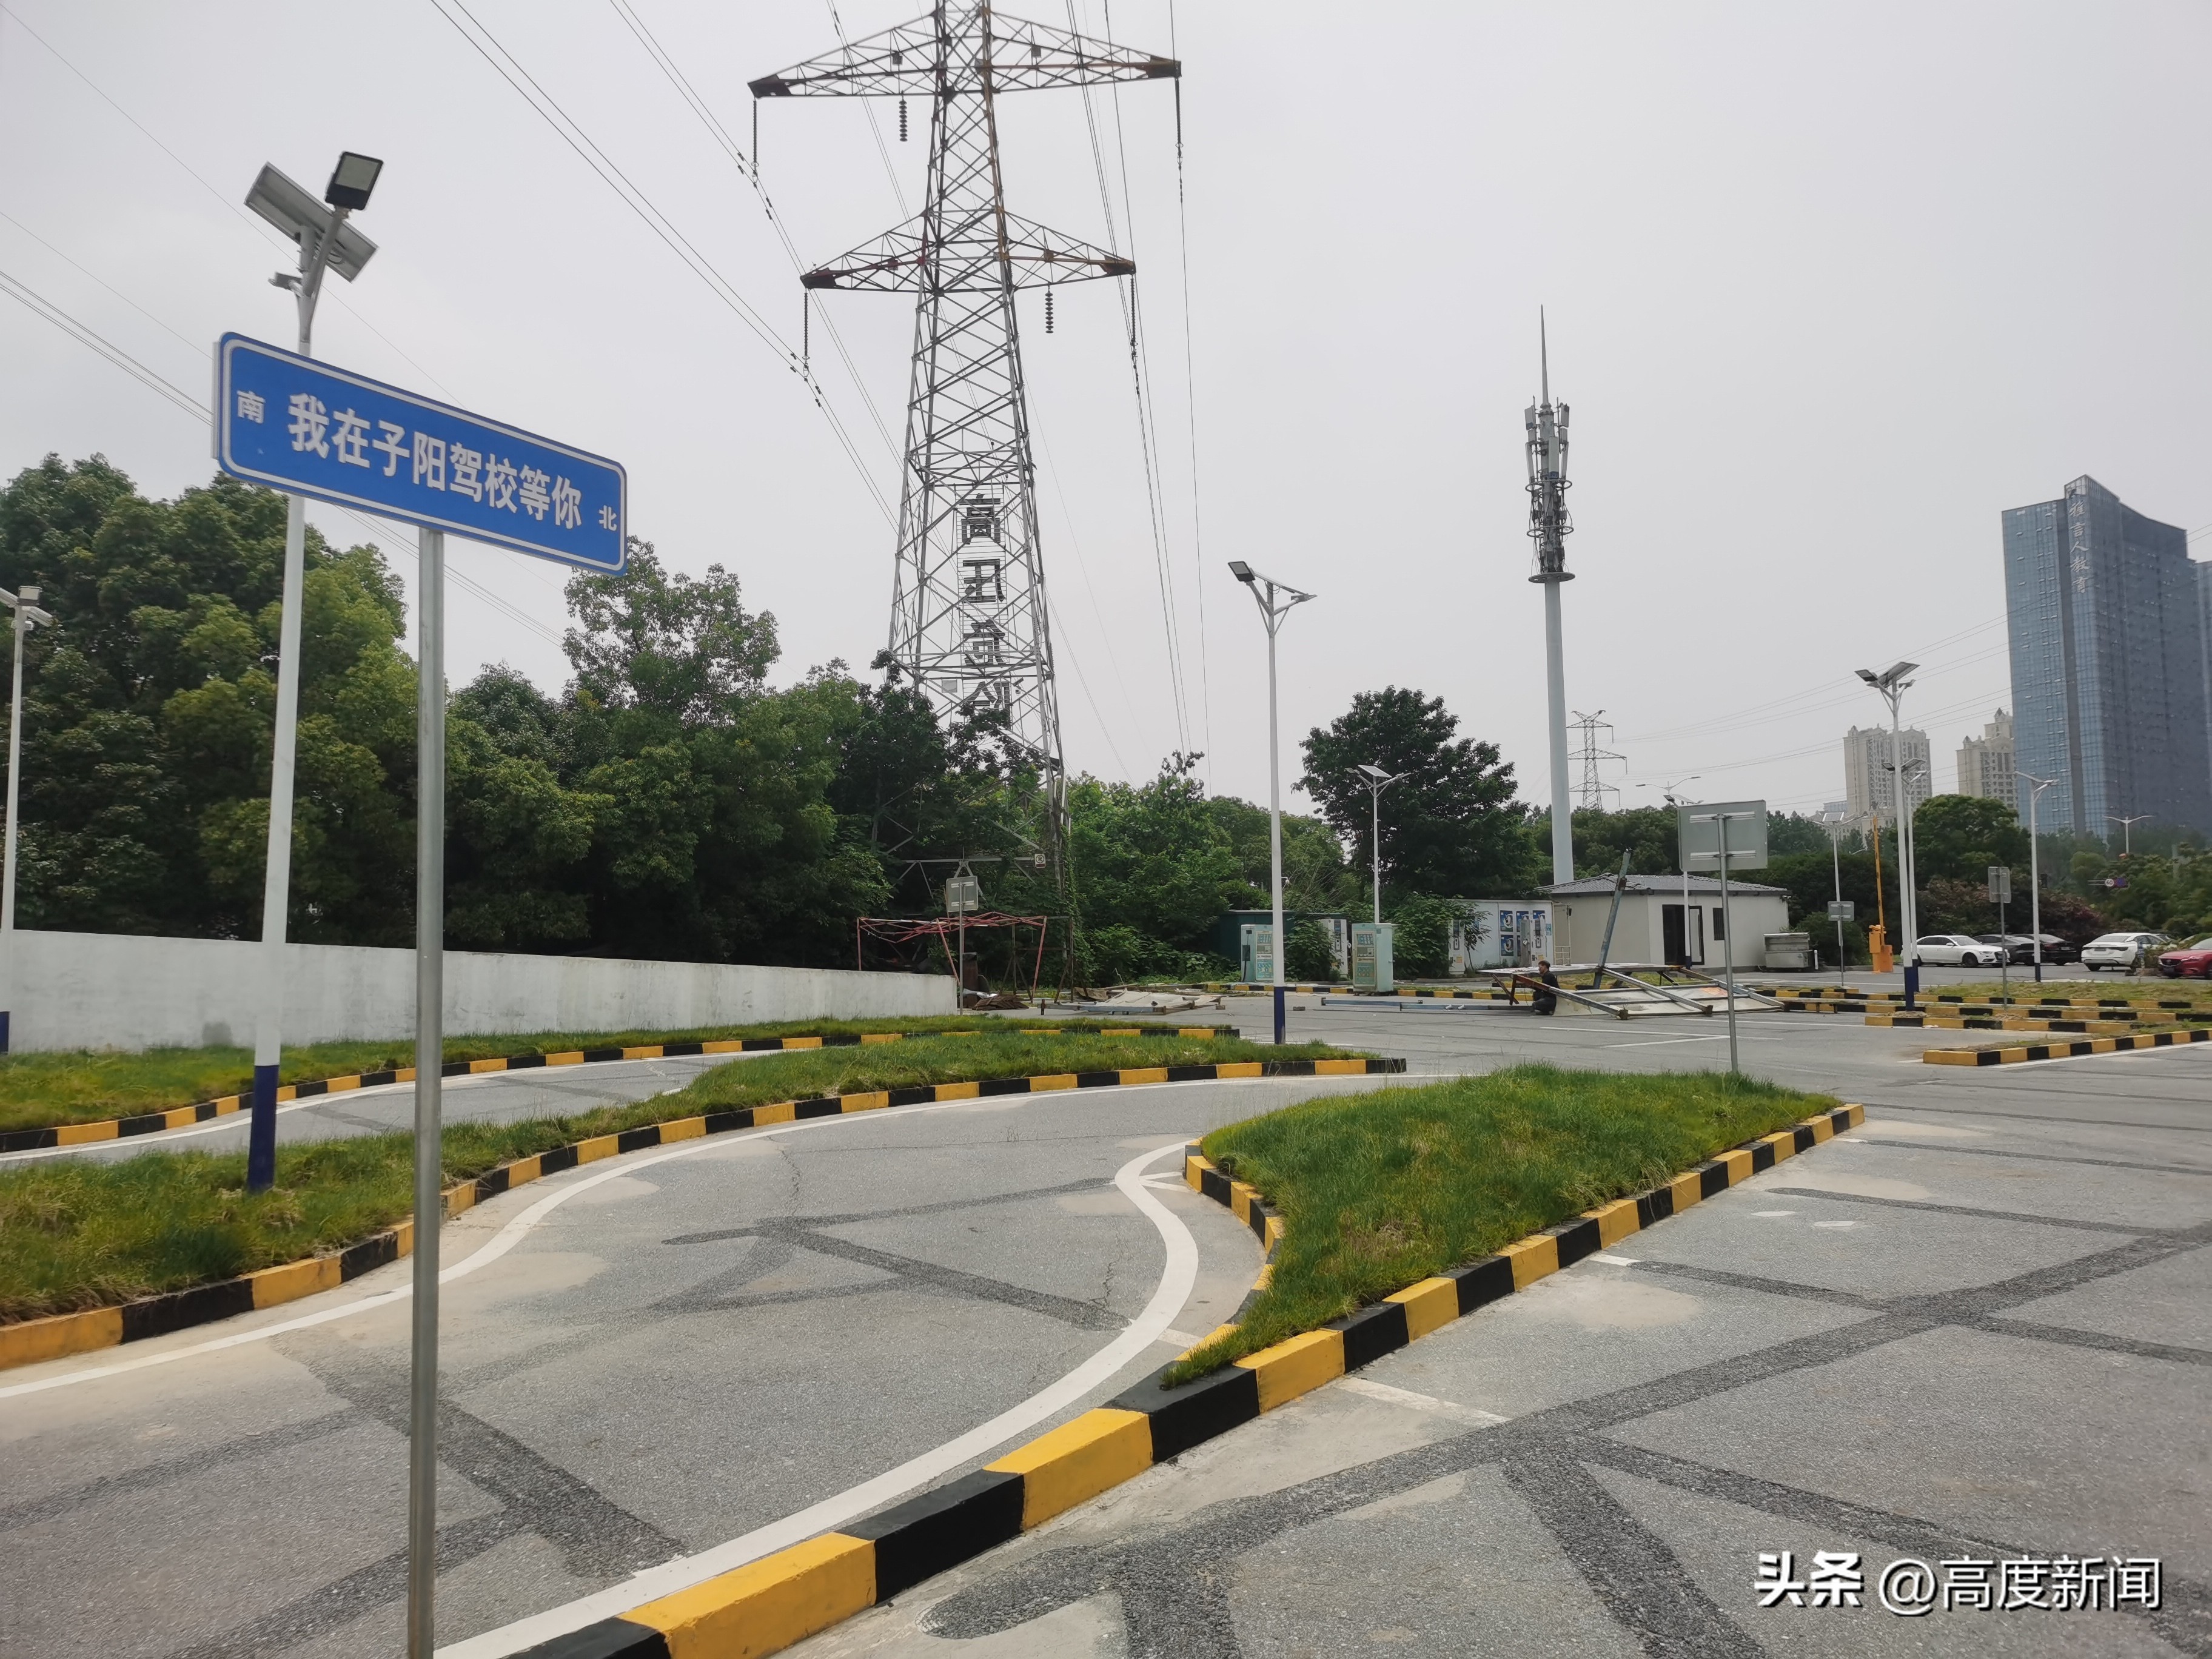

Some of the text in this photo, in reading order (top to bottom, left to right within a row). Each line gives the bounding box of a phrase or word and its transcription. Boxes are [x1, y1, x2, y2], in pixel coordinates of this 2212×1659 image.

[236, 390, 617, 532] 南 我在子阳驾校等你 北
